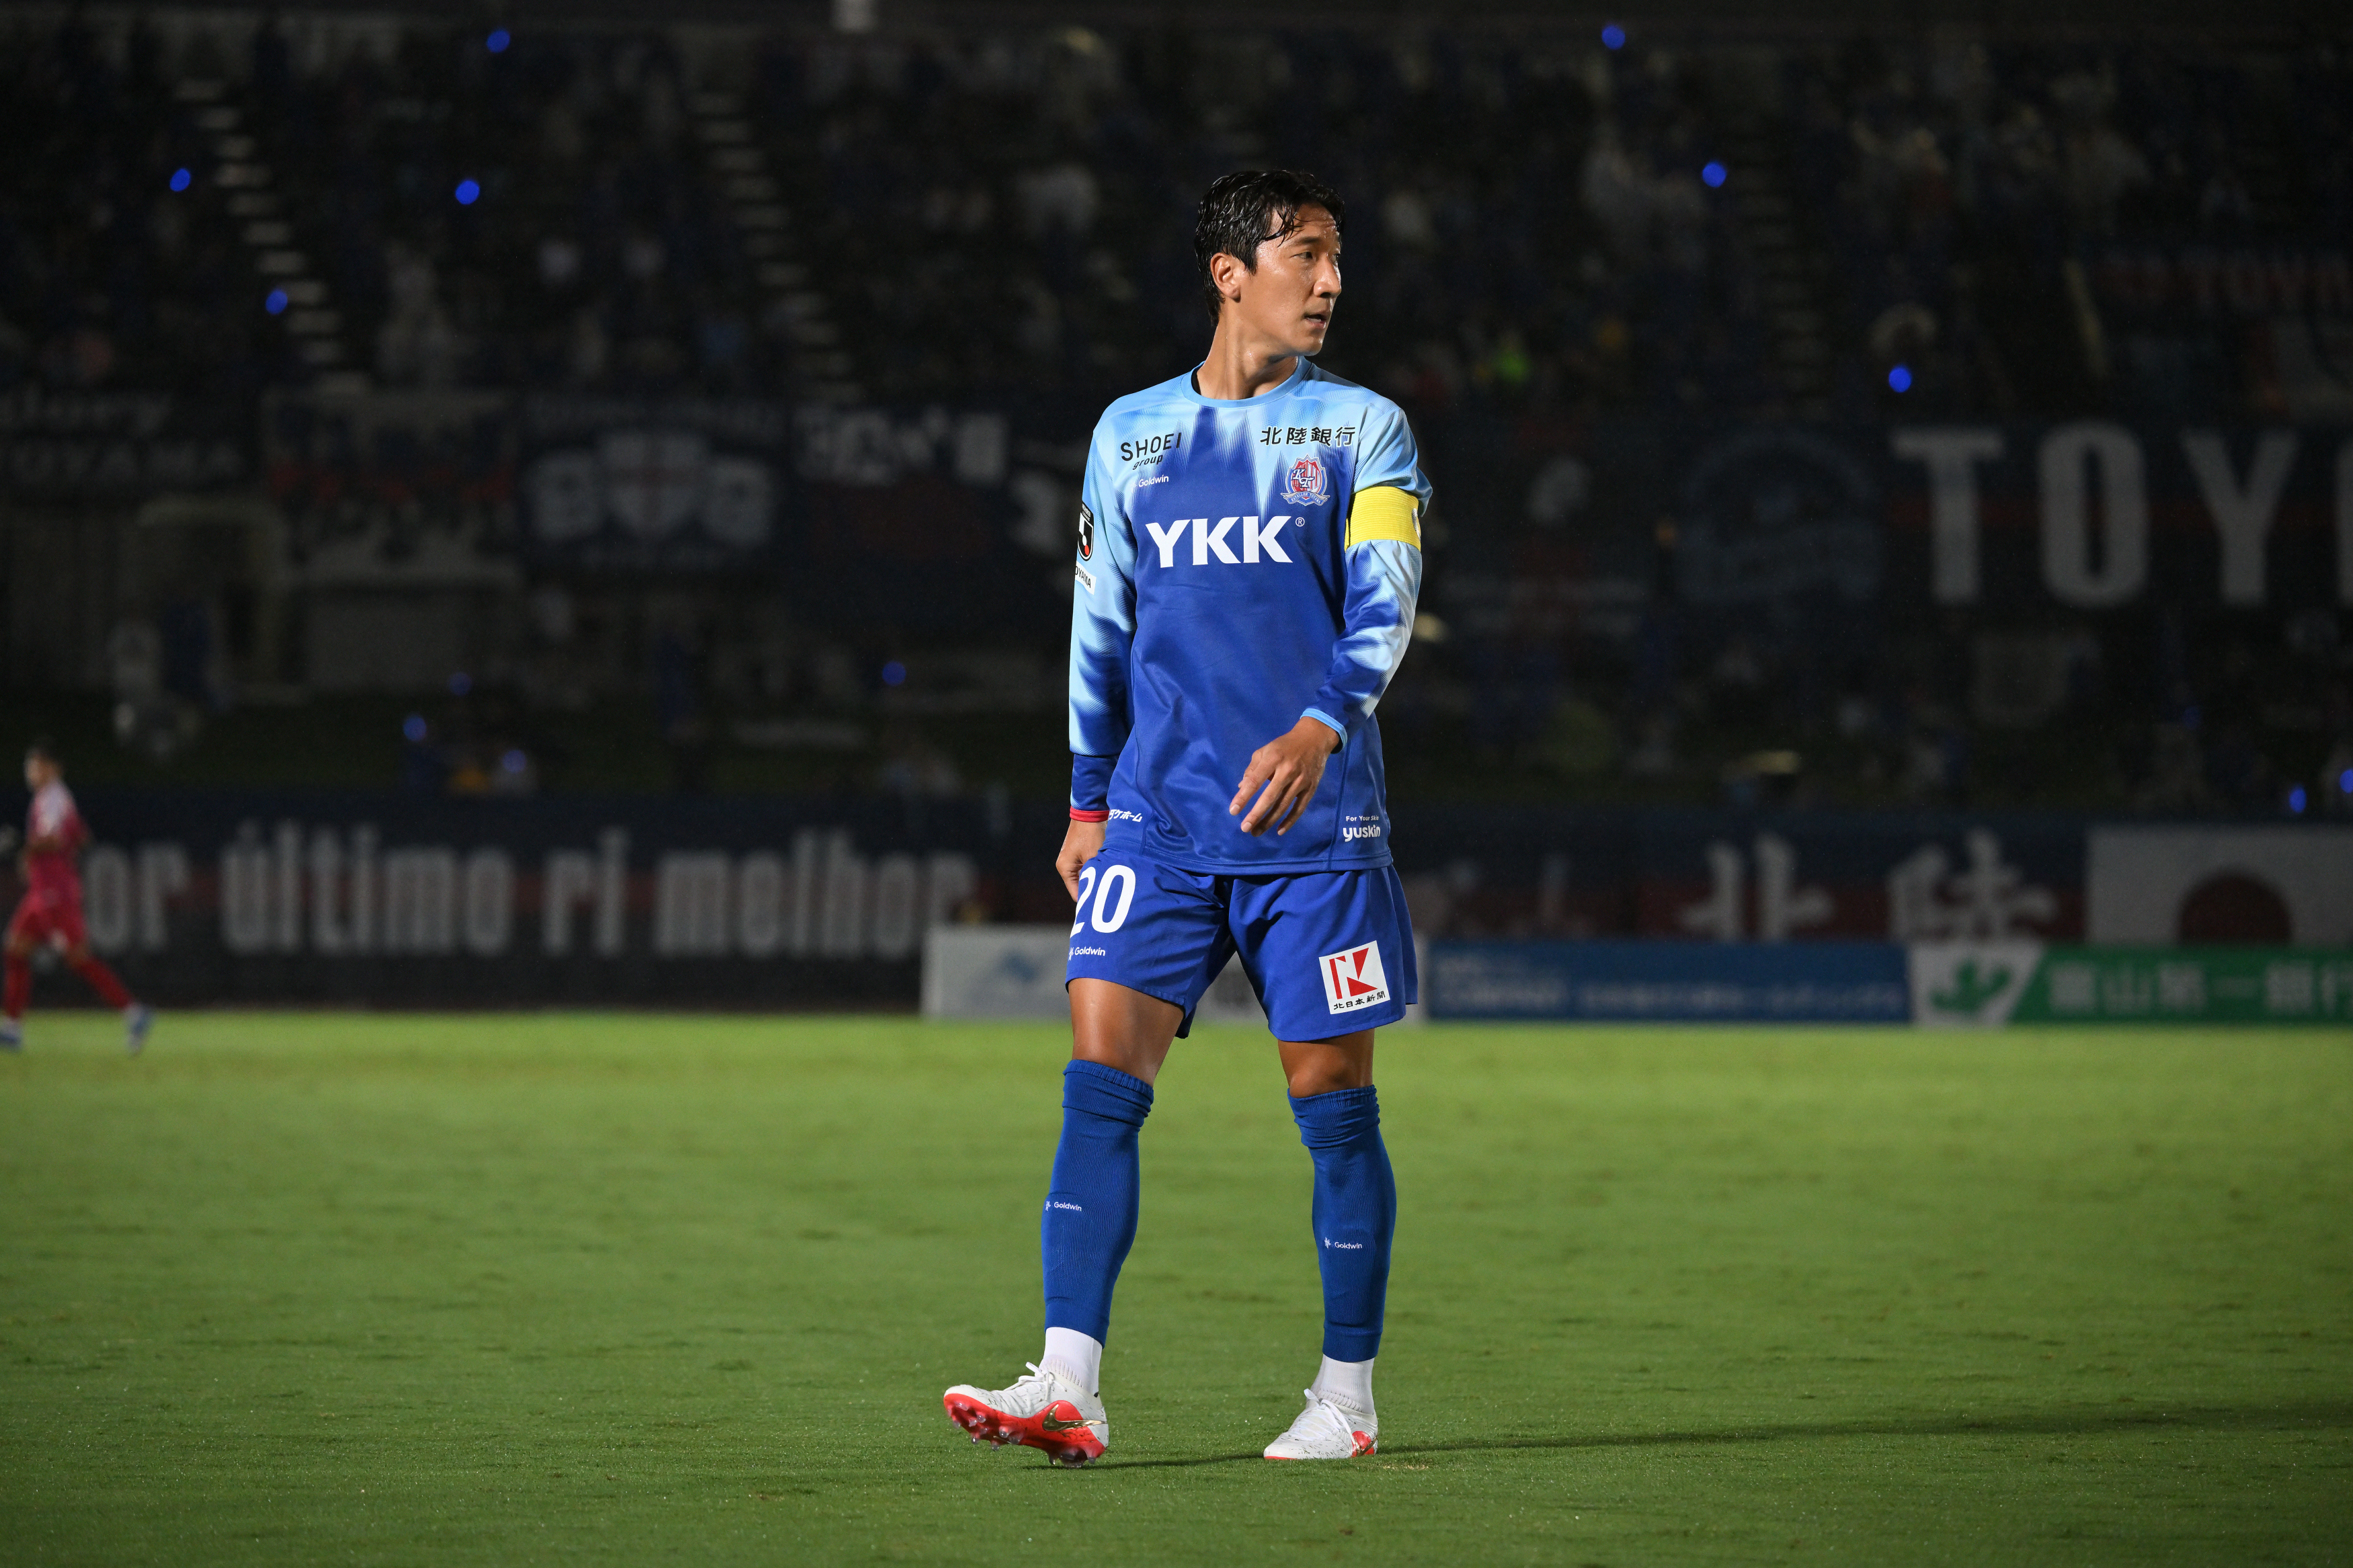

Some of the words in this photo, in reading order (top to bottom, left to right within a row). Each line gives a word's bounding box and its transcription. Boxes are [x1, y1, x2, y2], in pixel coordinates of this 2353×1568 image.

[1260, 426, 1356, 447] 北陸銀行
[1120, 432, 1182, 462] SHOEI
[1132, 454, 1163, 470] group
[1138, 474, 1169, 487] Goldwin
[1888, 418, 2353, 607] TOY
[1145, 515, 1293, 569] YKK
[1343, 824, 1381, 842] yuskin
[81, 840, 191, 954] or
[653, 824, 980, 960] melhor
[1070, 864, 1136, 938] 20
[1074, 946, 1106, 956] Goldwin
[1333, 991, 1386, 1010] 北日本新聞
[1053, 1201, 1082, 1212] Goldwin
[1334, 1241, 1363, 1249] Goldwin
